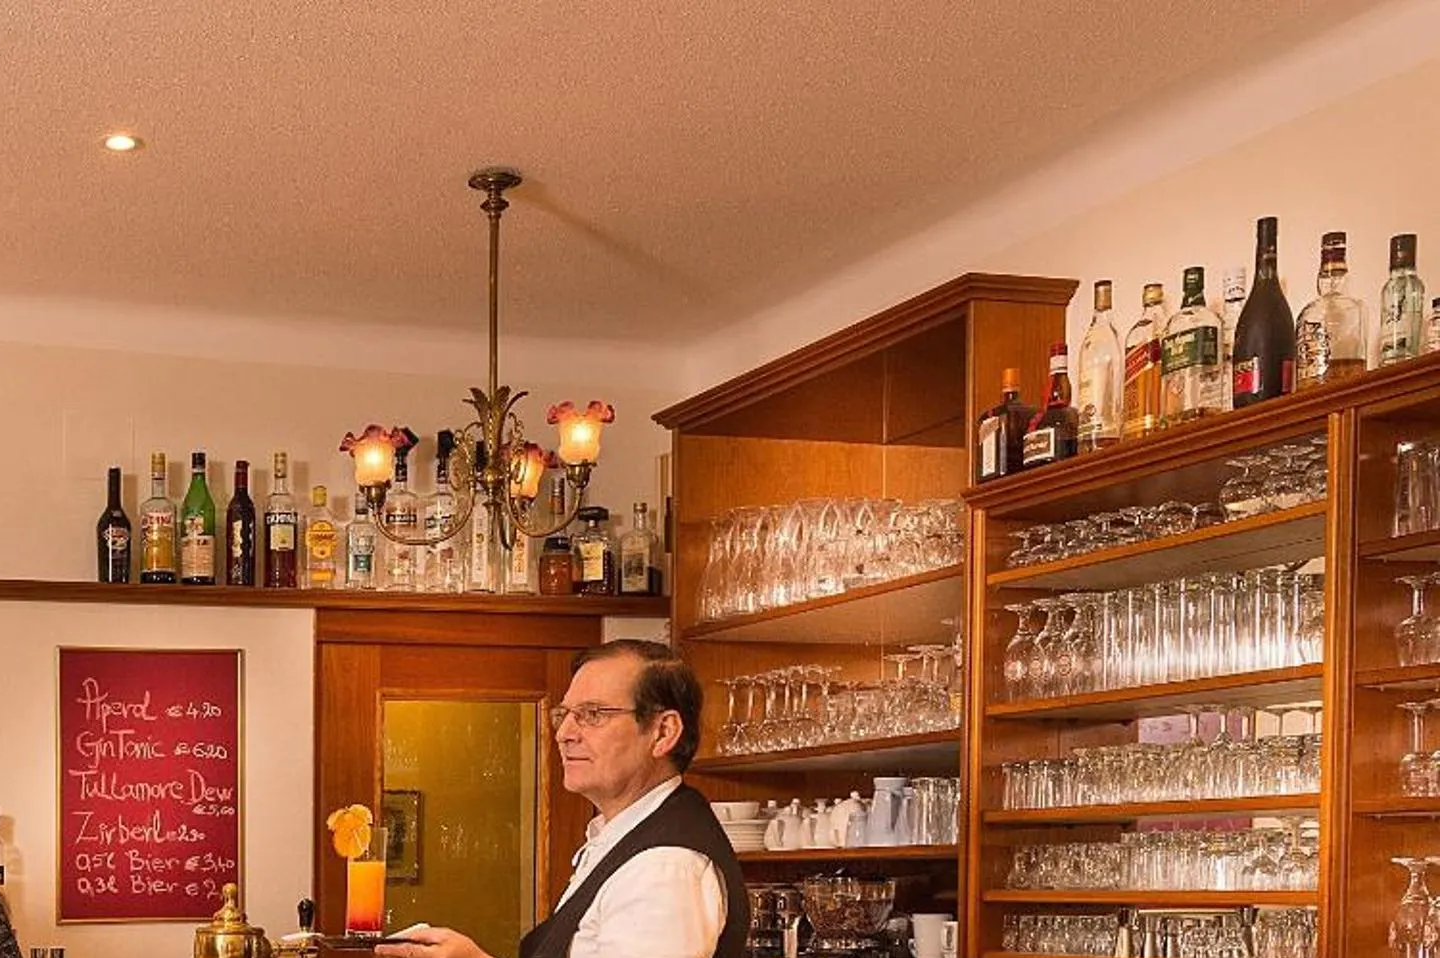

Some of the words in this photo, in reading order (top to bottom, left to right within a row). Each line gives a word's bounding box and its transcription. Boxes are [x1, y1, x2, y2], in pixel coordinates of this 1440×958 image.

[68, 769, 184, 801] Tullamore
[185, 769, 234, 805] Dew
[124, 850, 180, 873] Bier
[129, 873, 180, 896] Bier
